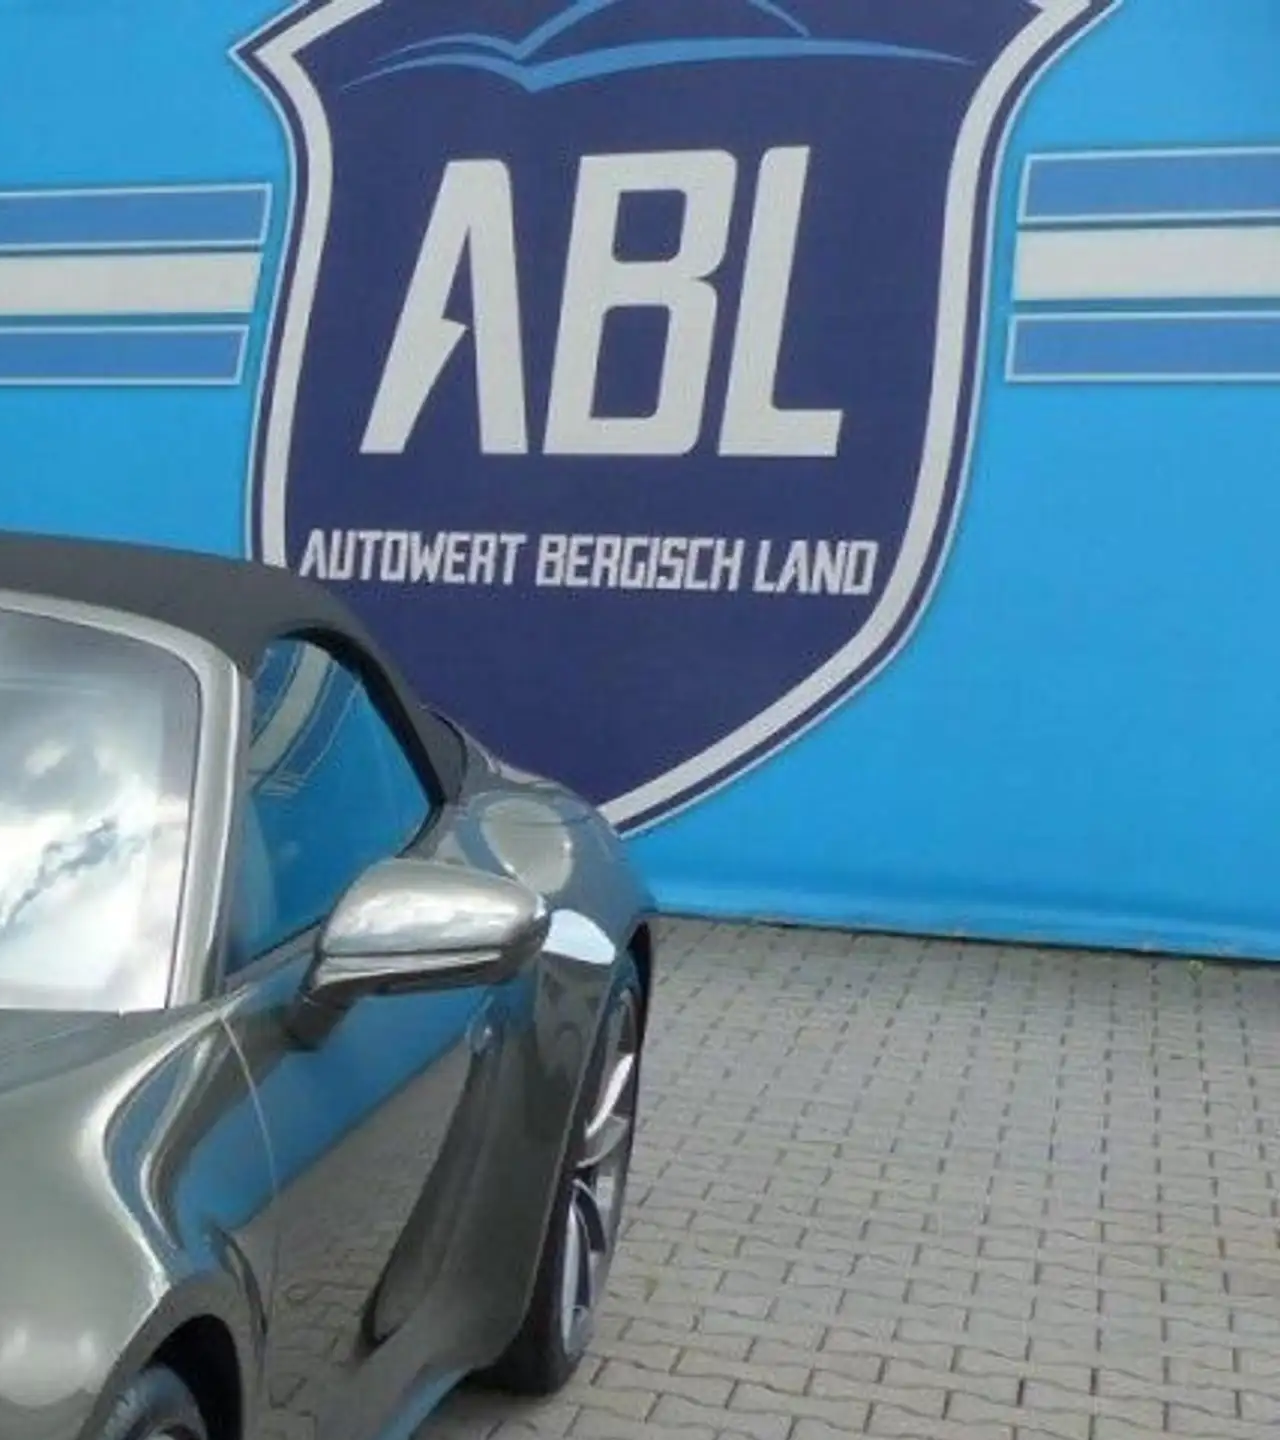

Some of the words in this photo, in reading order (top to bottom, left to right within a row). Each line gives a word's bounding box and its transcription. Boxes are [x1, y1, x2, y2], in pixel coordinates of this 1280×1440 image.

[359, 145, 843, 457] ABL
[298, 528, 528, 586] AUTOWERT
[535, 533, 745, 591] BERGISCH
[752, 539, 879, 596] LAND
